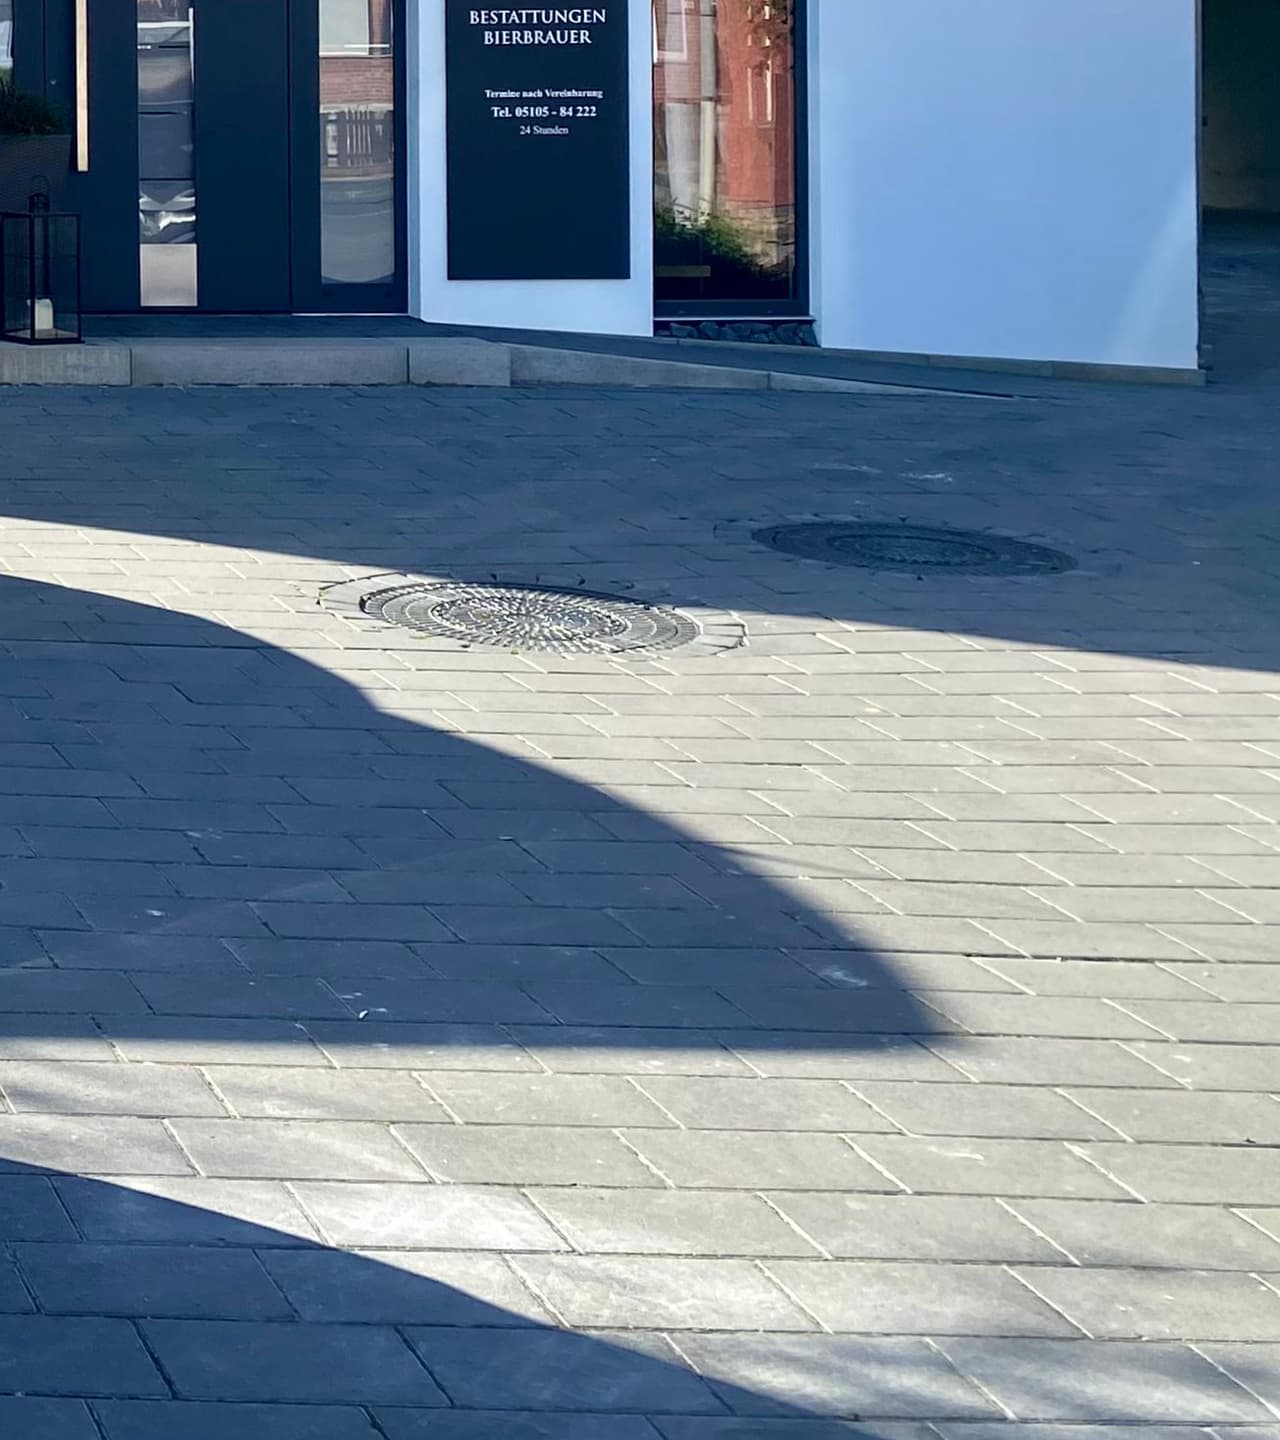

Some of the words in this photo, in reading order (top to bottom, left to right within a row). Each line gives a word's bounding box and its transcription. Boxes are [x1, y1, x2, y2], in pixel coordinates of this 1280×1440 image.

[469, 9, 606, 24] BESTATTUNGEN
[484, 30, 592, 45] BIERBRAUER
[484, 89, 521, 98] Termine
[522, 89, 543, 98] nach
[545, 89, 603, 99] Vereinbarung
[491, 107, 512, 117] Tel.
[515, 107, 549, 117] 05105
[559, 106, 573, 117] 84
[576, 106, 597, 116] 222
[519, 125, 531, 135] 24
[533, 125, 569, 135] Stunden
